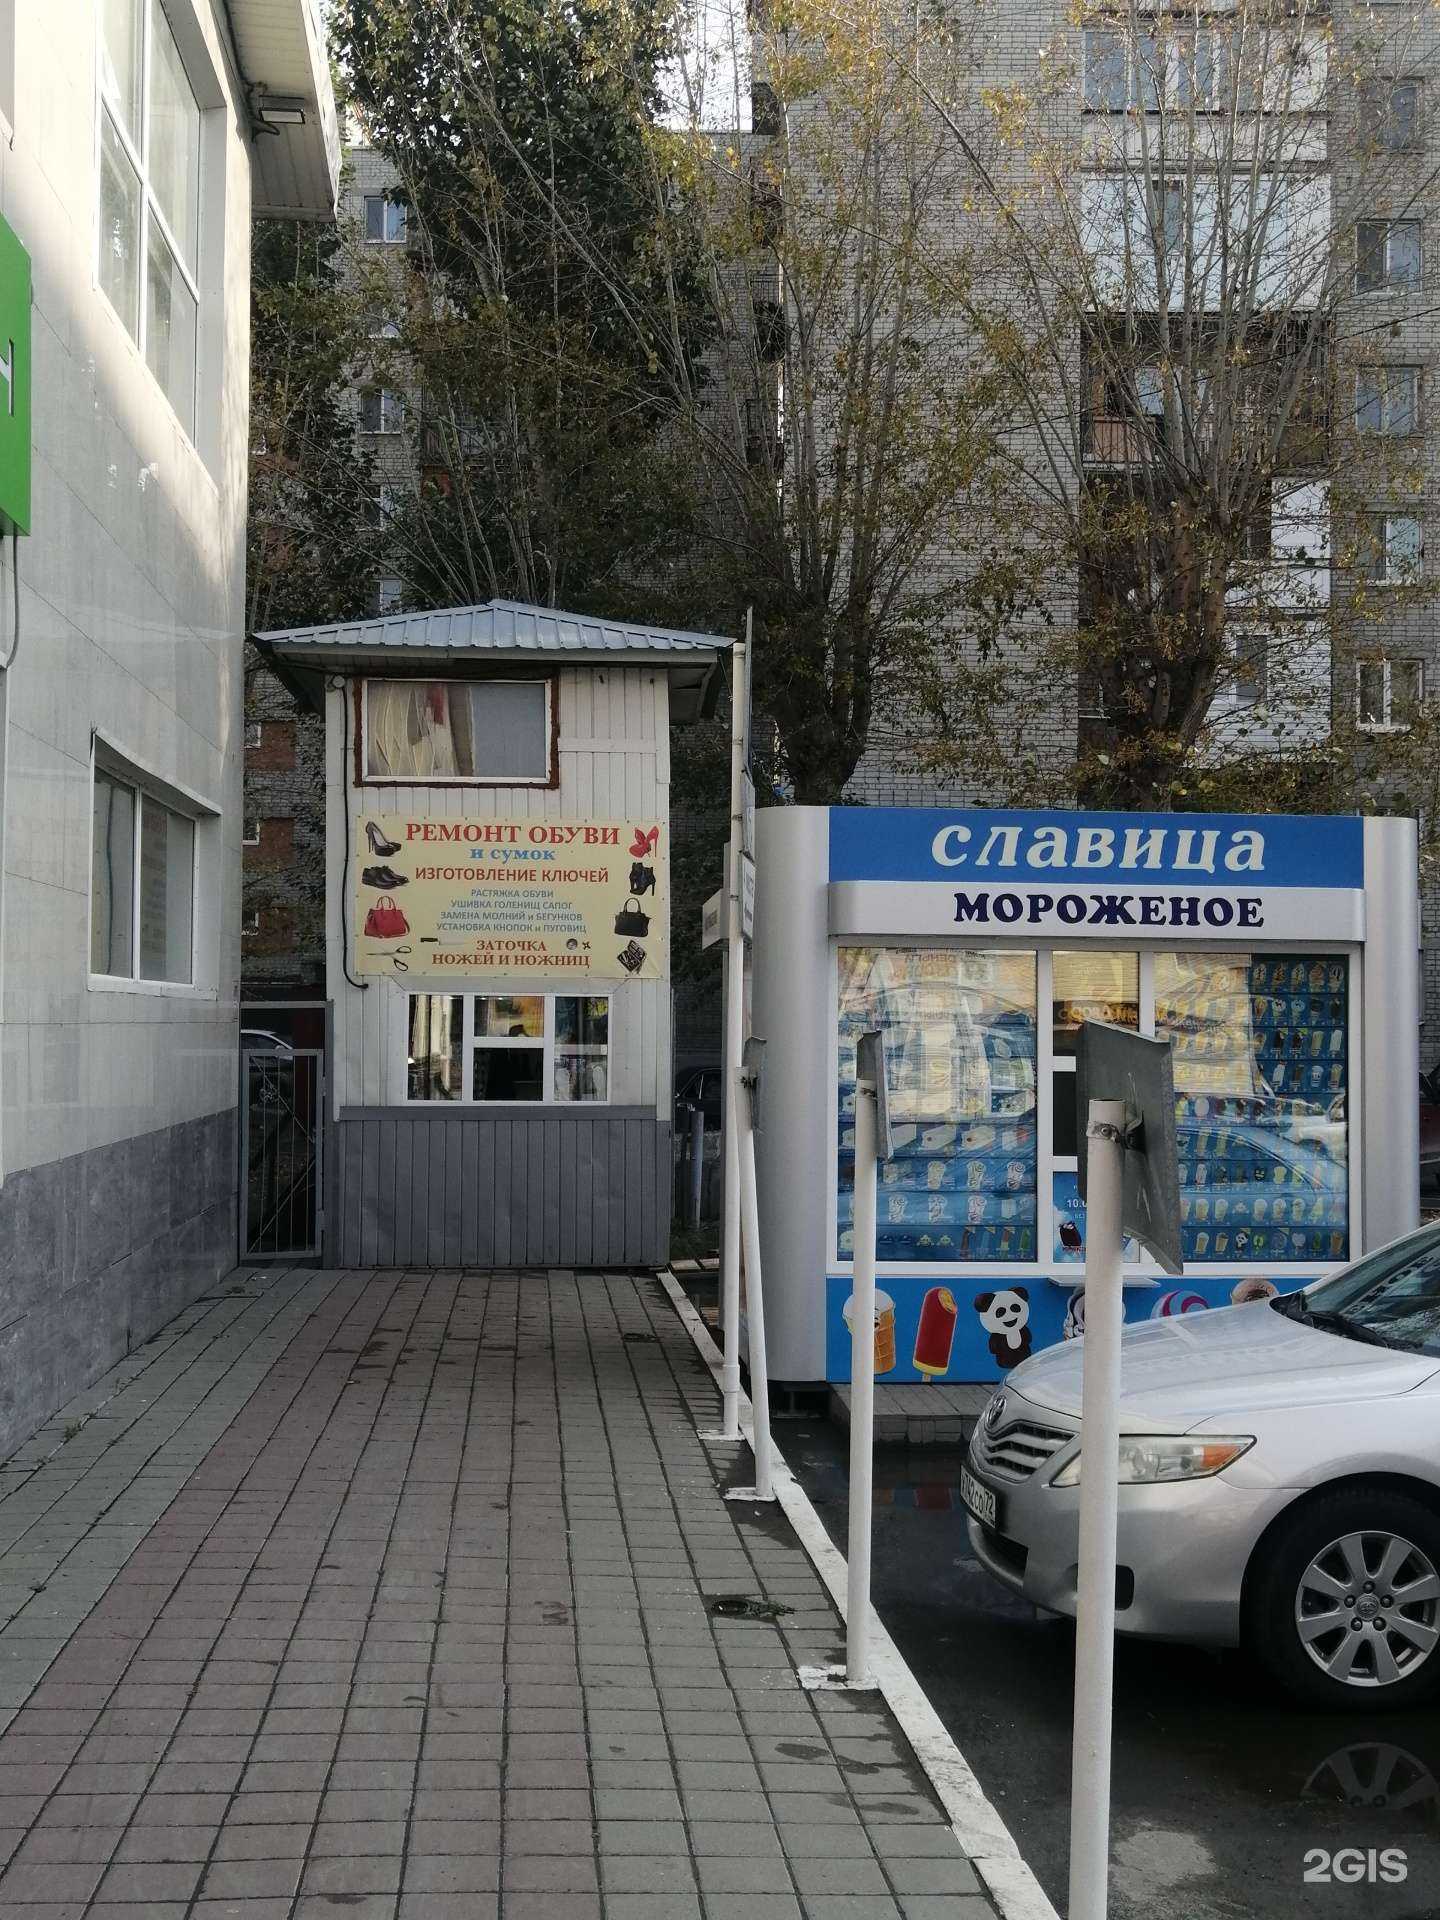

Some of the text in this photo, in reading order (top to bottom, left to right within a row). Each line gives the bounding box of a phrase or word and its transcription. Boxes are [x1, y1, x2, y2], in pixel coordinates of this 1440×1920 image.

[405, 823, 620, 845] РЕМОНТ ОБУВИ
[470, 848, 556, 864] и сумок
[415, 867, 609, 883] ИЗГОТОВЛЕНИЕ КЛЮЧЕЙ
[471, 889, 554, 898] РАСТЯЖКА ОБУВИ
[451, 900, 573, 910] УШИВКА ГОЛЕНИЩ САПОГ
[953, 892, 1265, 928] МОРОЖЕНОЕ
[440, 912, 480, 920] ЗАМЕНА
[482, 911, 526, 921] МОЛНИЙ
[536, 912, 583, 922] БЕГУНКОВ
[436, 922, 491, 932] УСТАНОВКА
[493, 923, 533, 932] КНОПОК
[543, 924, 587, 934] ПУГОВИЦ
[476, 939, 548, 952] ЗАТОЧКА
[432, 952, 590, 968] НОЖЕЙ И НОЖНИЦ
